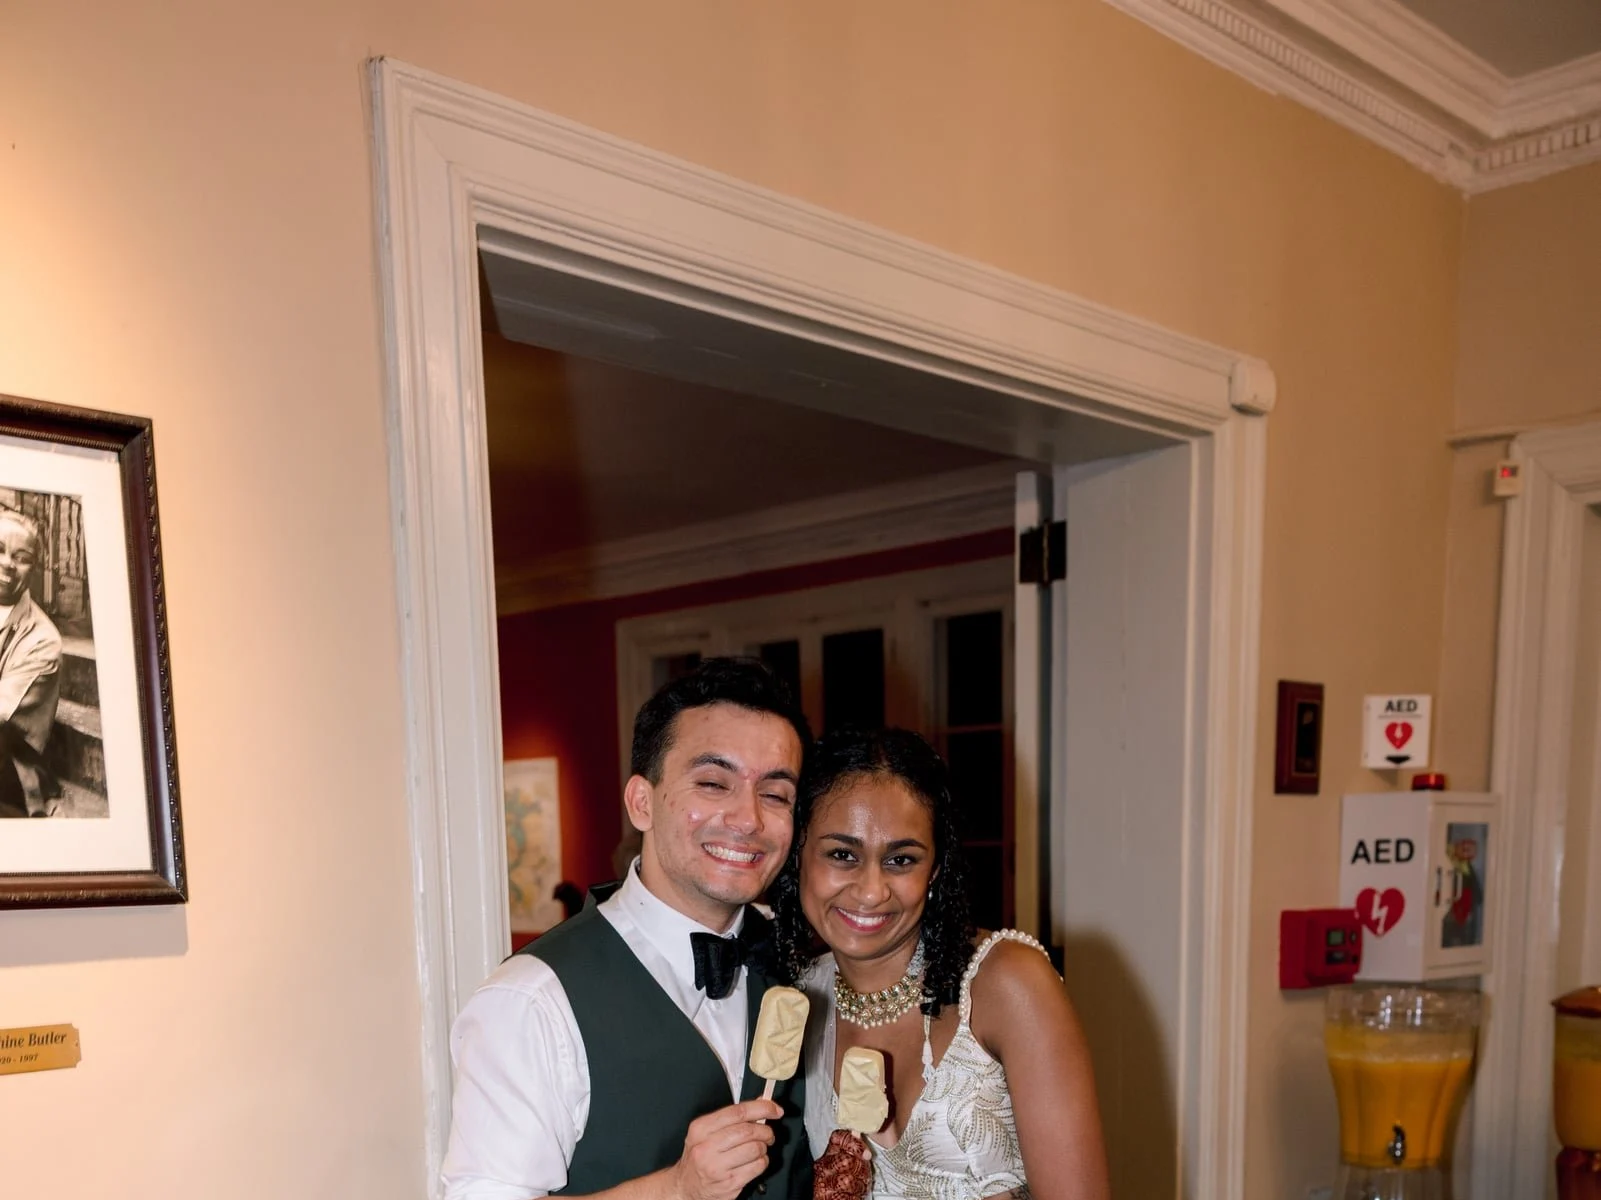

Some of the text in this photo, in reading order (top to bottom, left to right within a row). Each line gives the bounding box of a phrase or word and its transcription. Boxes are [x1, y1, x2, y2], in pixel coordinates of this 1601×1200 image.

[1384, 700, 1418, 713] AED
[1351, 838, 1415, 865] AED
[28, 1032, 67, 1047] Butler
